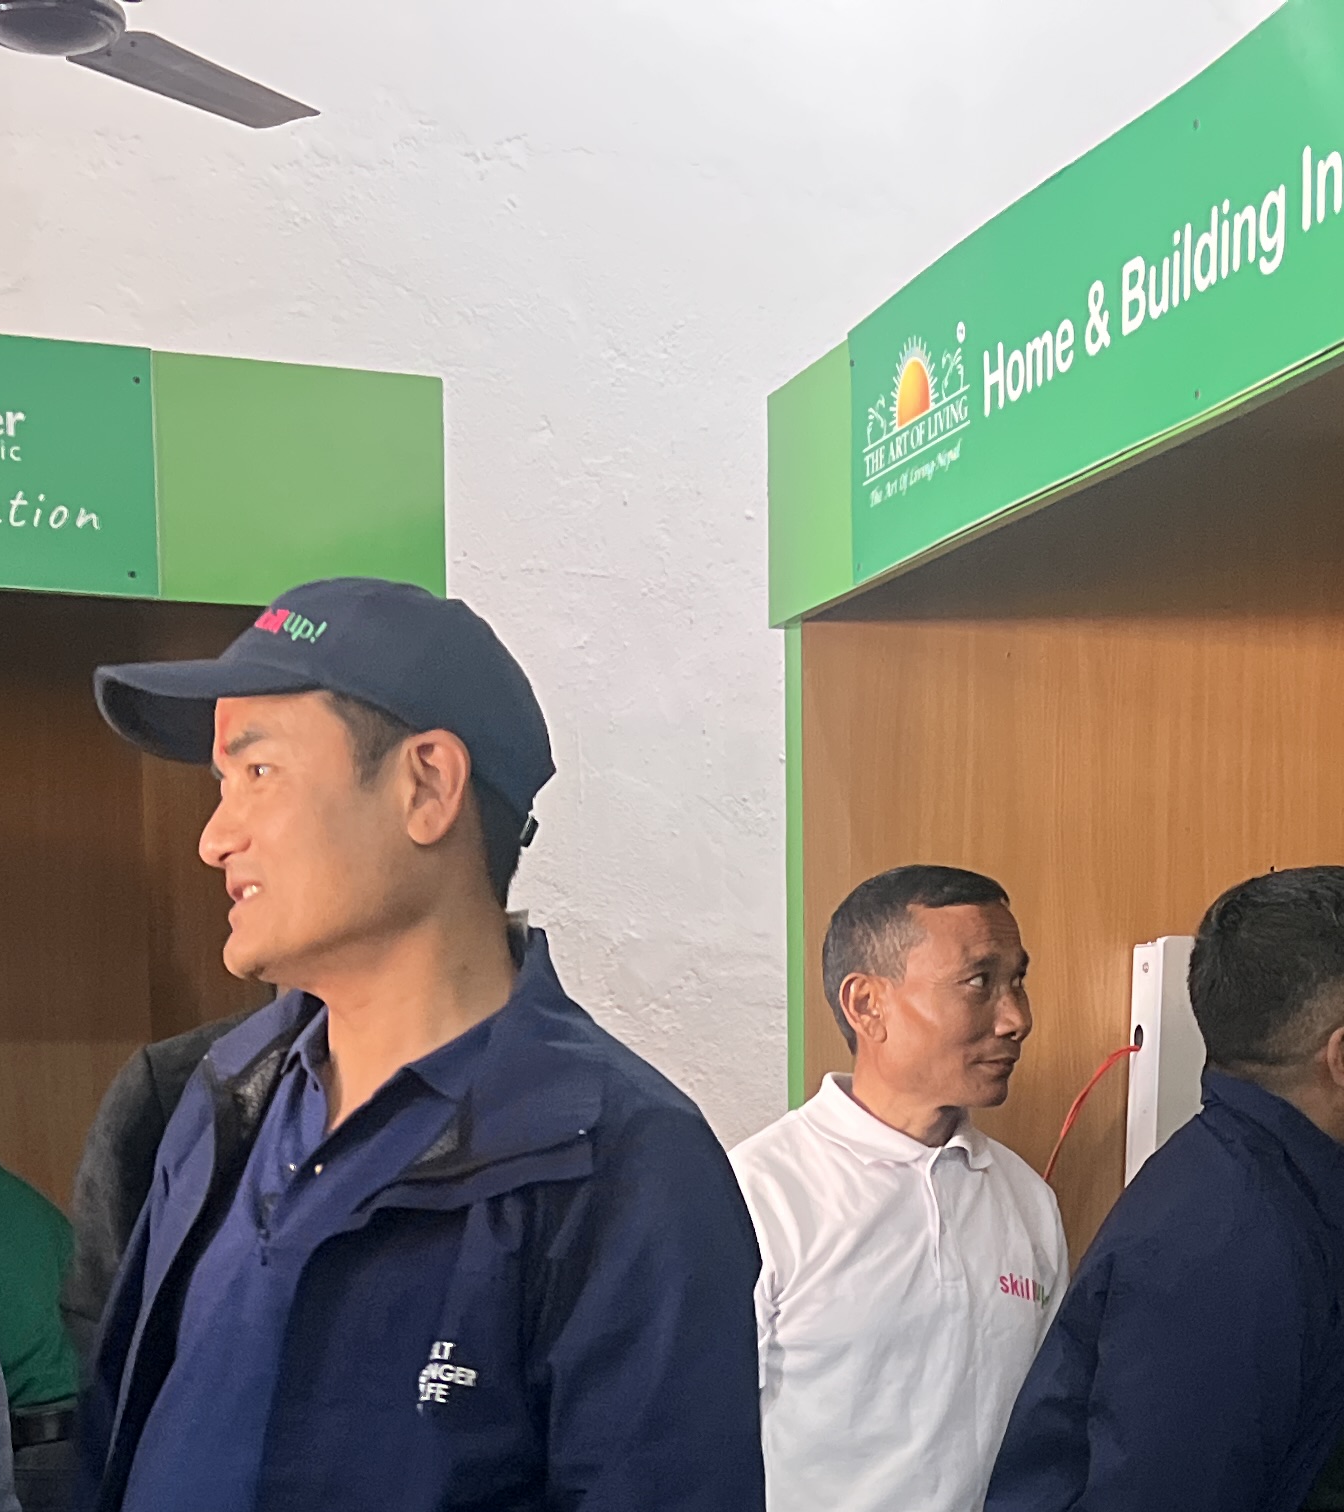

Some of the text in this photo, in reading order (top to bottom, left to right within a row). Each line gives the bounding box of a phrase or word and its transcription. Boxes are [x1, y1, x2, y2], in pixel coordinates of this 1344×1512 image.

[982, 318, 1075, 418] Home
[1084, 279, 1111, 356] &
[1121, 184, 1286, 336] Building
[864, 395, 969, 478] THE ART OF LIVING
